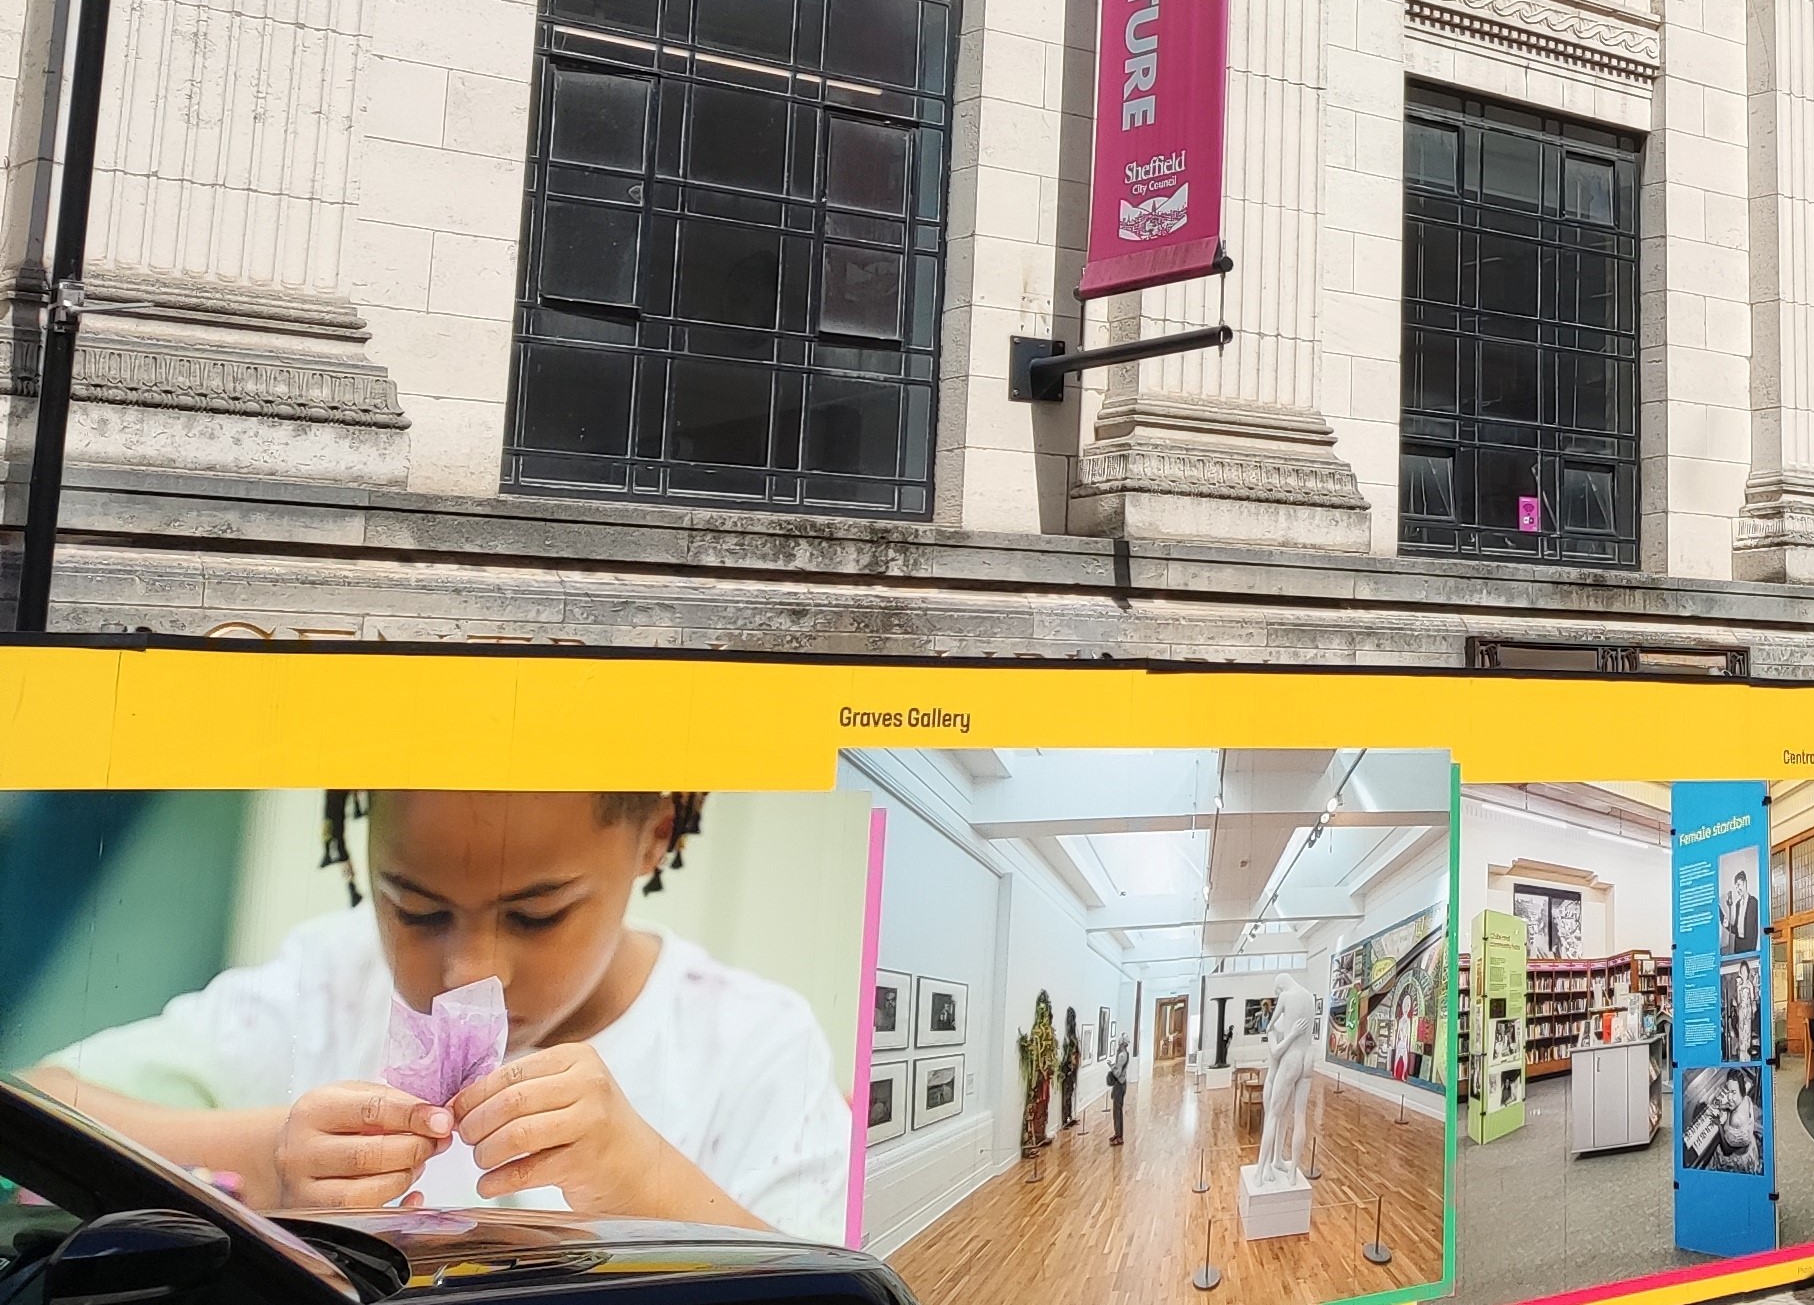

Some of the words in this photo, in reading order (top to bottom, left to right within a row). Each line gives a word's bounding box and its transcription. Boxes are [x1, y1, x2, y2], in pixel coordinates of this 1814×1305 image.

[1124, 149, 1187, 184] Sheffield
[1132, 184, 1147, 196] City
[1148, 175, 1177, 191] Council
[839, 706, 903, 728] Graves
[907, 707, 971, 734] Gallery
[1678, 827, 1712, 847] Female
[1712, 813, 1751, 837] stardom
